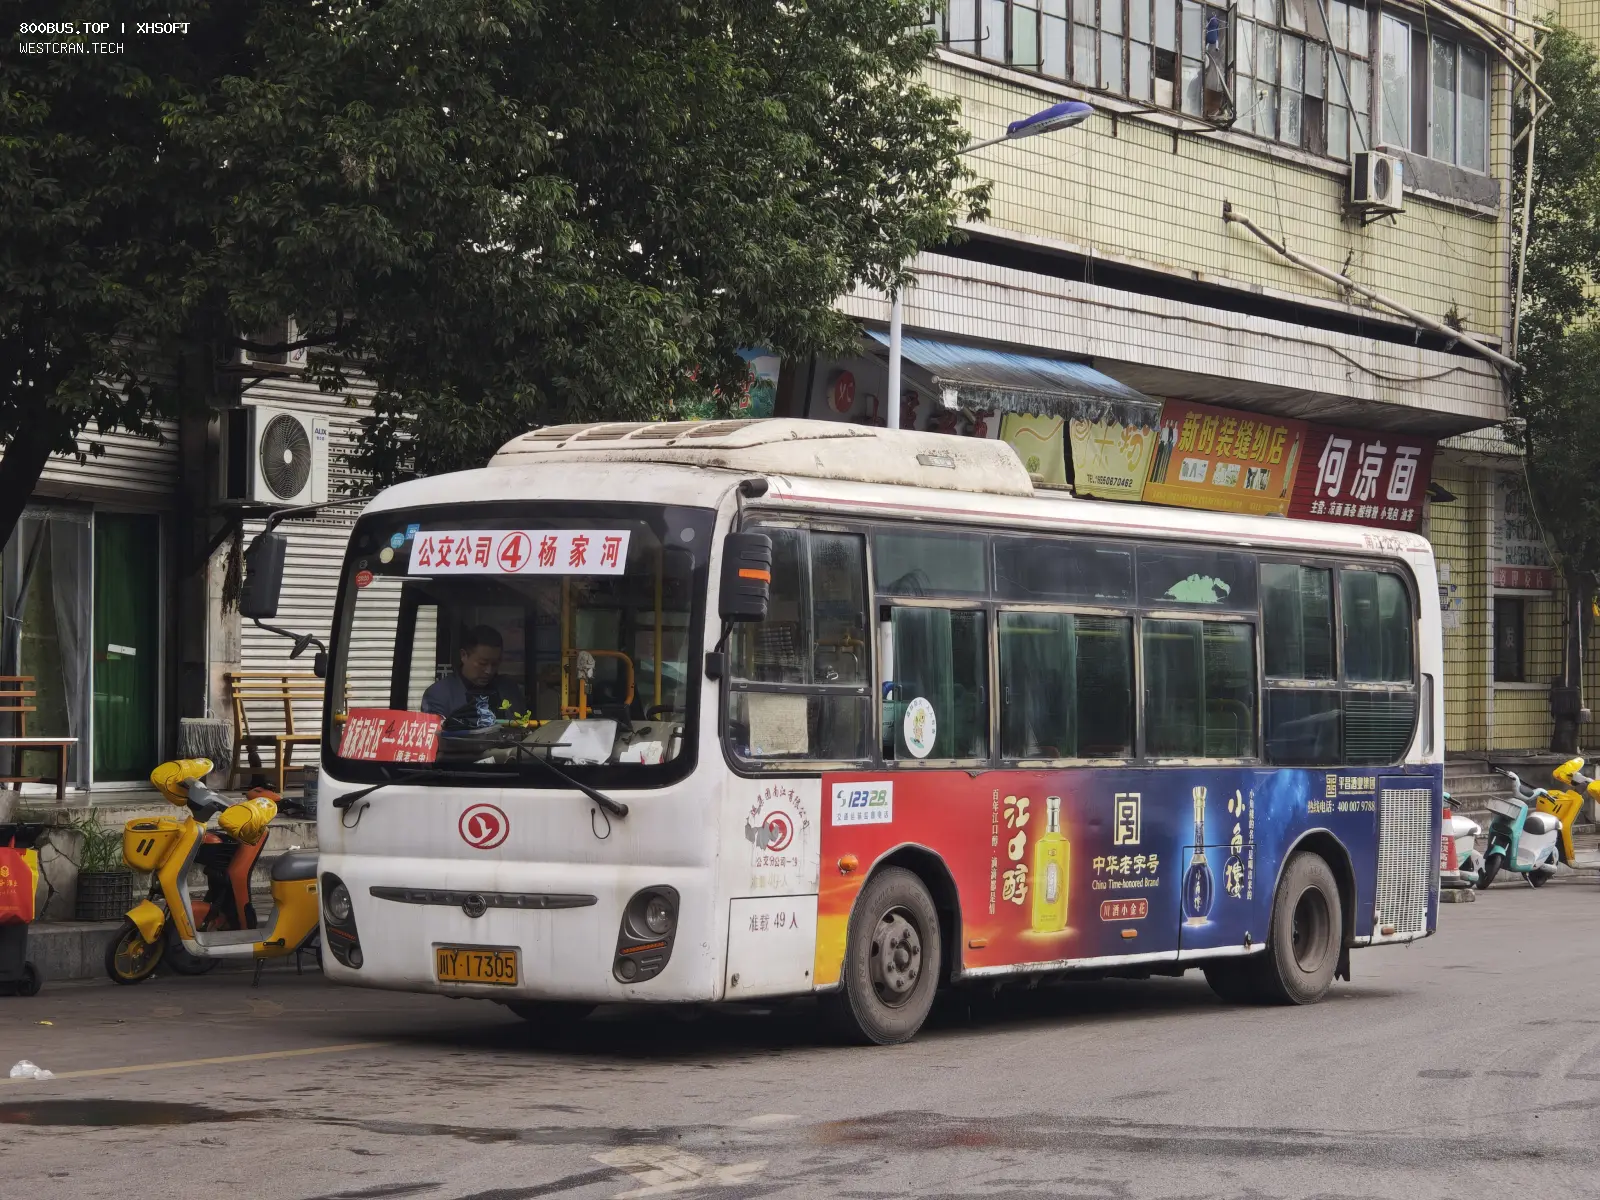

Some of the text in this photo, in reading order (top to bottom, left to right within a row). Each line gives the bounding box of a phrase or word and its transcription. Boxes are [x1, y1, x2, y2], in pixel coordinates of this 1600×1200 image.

[1314, 434, 1421, 501] 何凉面
[418, 535, 493, 568] 公交公司
[538, 534, 622, 568] 杨家河
[397, 720, 438, 750] 公交公司
[1337, 801, 1349, 812] 400
[1349, 801, 1360, 812] 007
[1361, 801, 1376, 812] 9788
[1092, 853, 1160, 876] 中华老字号
[1092, 877, 1159, 890] China Time-honored Brand
[1103, 902, 1146, 917] 川酒小金花
[773, 912, 786, 928] 49
